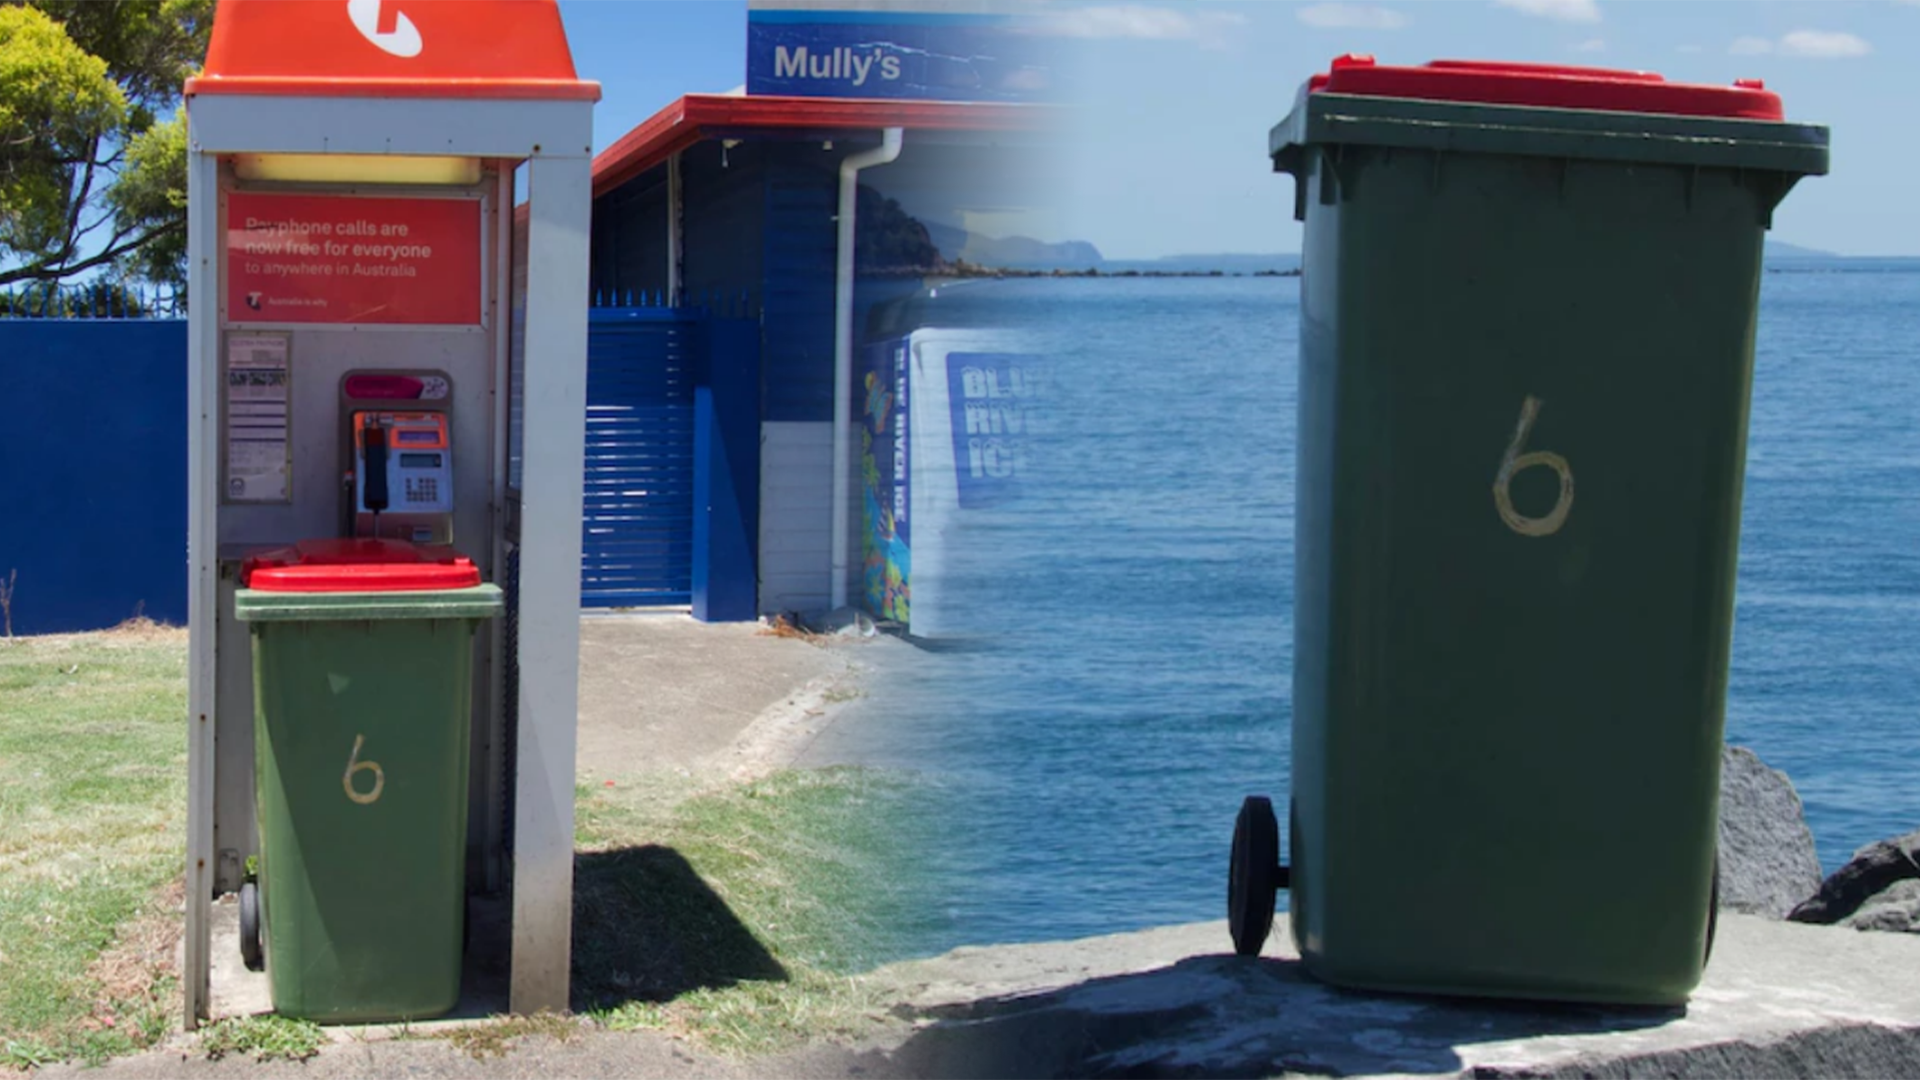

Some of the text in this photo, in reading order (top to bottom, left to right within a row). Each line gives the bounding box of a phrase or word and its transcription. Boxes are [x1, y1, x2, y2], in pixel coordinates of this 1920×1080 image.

[774, 45, 901, 86] Mully's
[245, 217, 409, 237] Payphone calls are
[245, 239, 432, 261] now free for everyone
[245, 261, 417, 278] to anywhere in Australia
[961, 366, 1053, 399] BLU
[893, 412, 907, 482] RIVER
[1493, 394, 1574, 537] 6
[893, 485, 907, 523] ICE
[342, 733, 385, 805] 6
